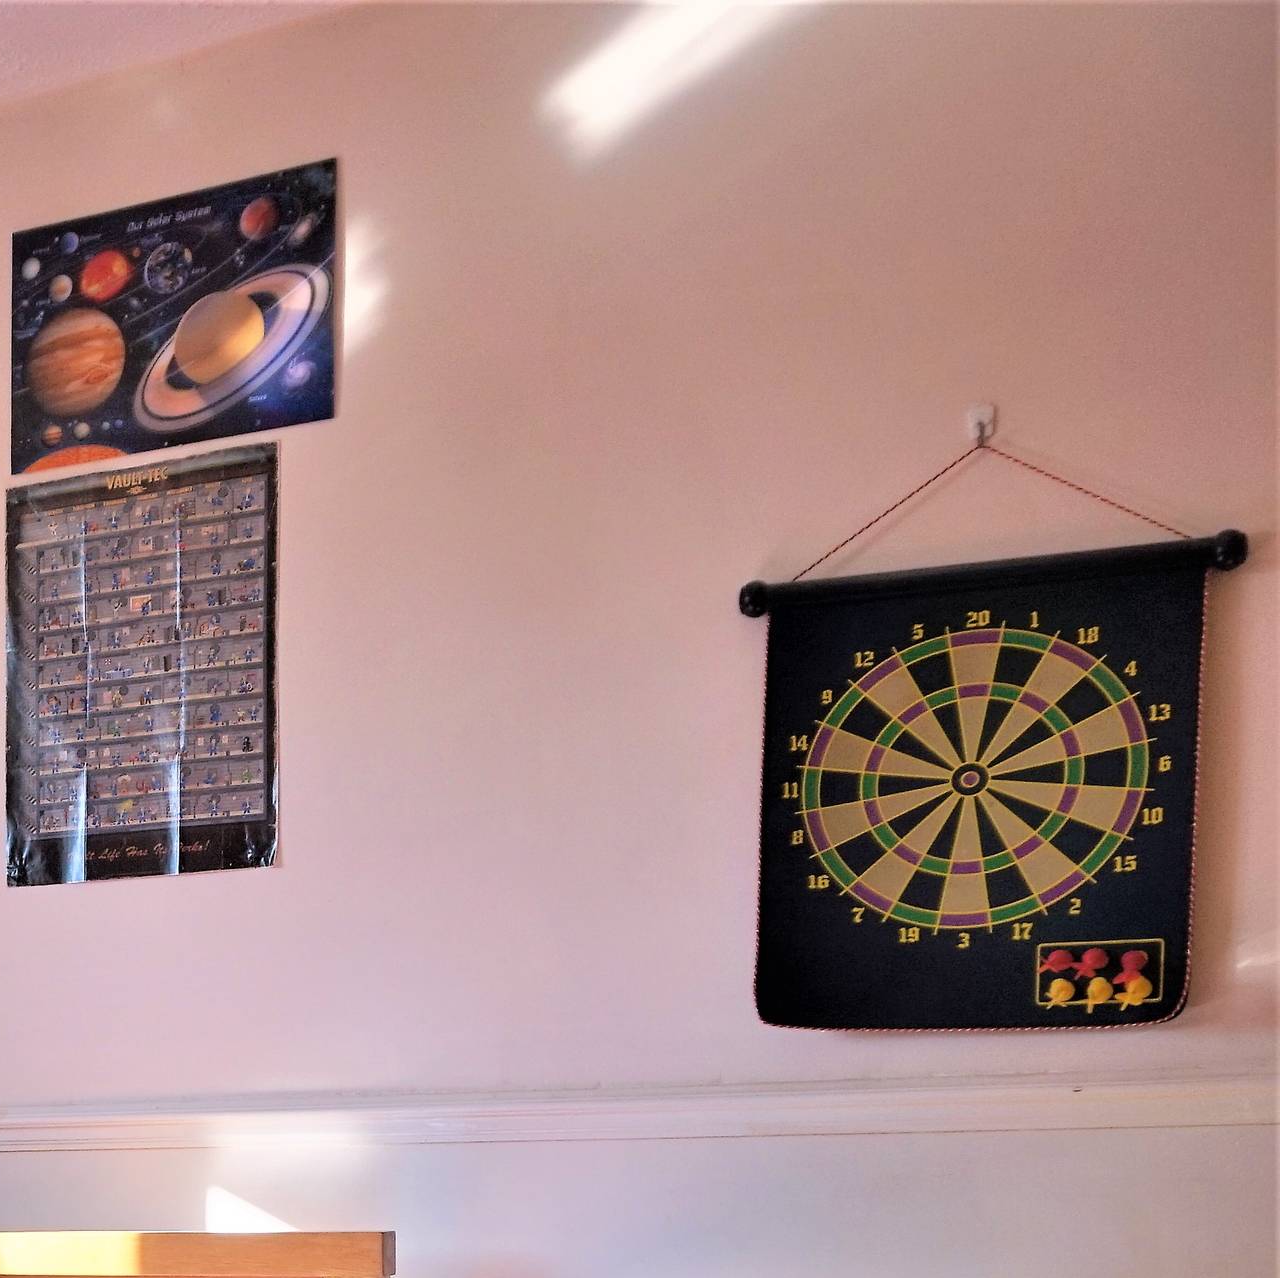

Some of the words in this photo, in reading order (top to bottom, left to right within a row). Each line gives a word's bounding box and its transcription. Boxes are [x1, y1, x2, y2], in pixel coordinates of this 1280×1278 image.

[175, 205, 212, 222] System
[965, 609, 991, 628] 20
[1030, 610, 1040, 629] 1
[912, 623, 924, 641] 5
[1077, 626, 1100, 645] 18
[854, 650, 875, 668] 12
[1123, 660, 1138, 677] 4
[821, 689, 833, 705] 9
[1148, 703, 1171, 722] 13
[790, 734, 809, 752] 14
[1158, 754, 1172, 773] 6
[782, 781, 799, 799] 11
[1141, 806, 1164, 826] 10
[791, 829, 804, 845] 8
[1113, 854, 1137, 873] 15
[807, 874, 830, 890] 16
[850, 906, 866, 924] 7
[1068, 897, 1082, 915] 2
[898, 926, 921, 944] 19
[956, 932, 971, 949] 3
[1011, 922, 1034, 941] 17
